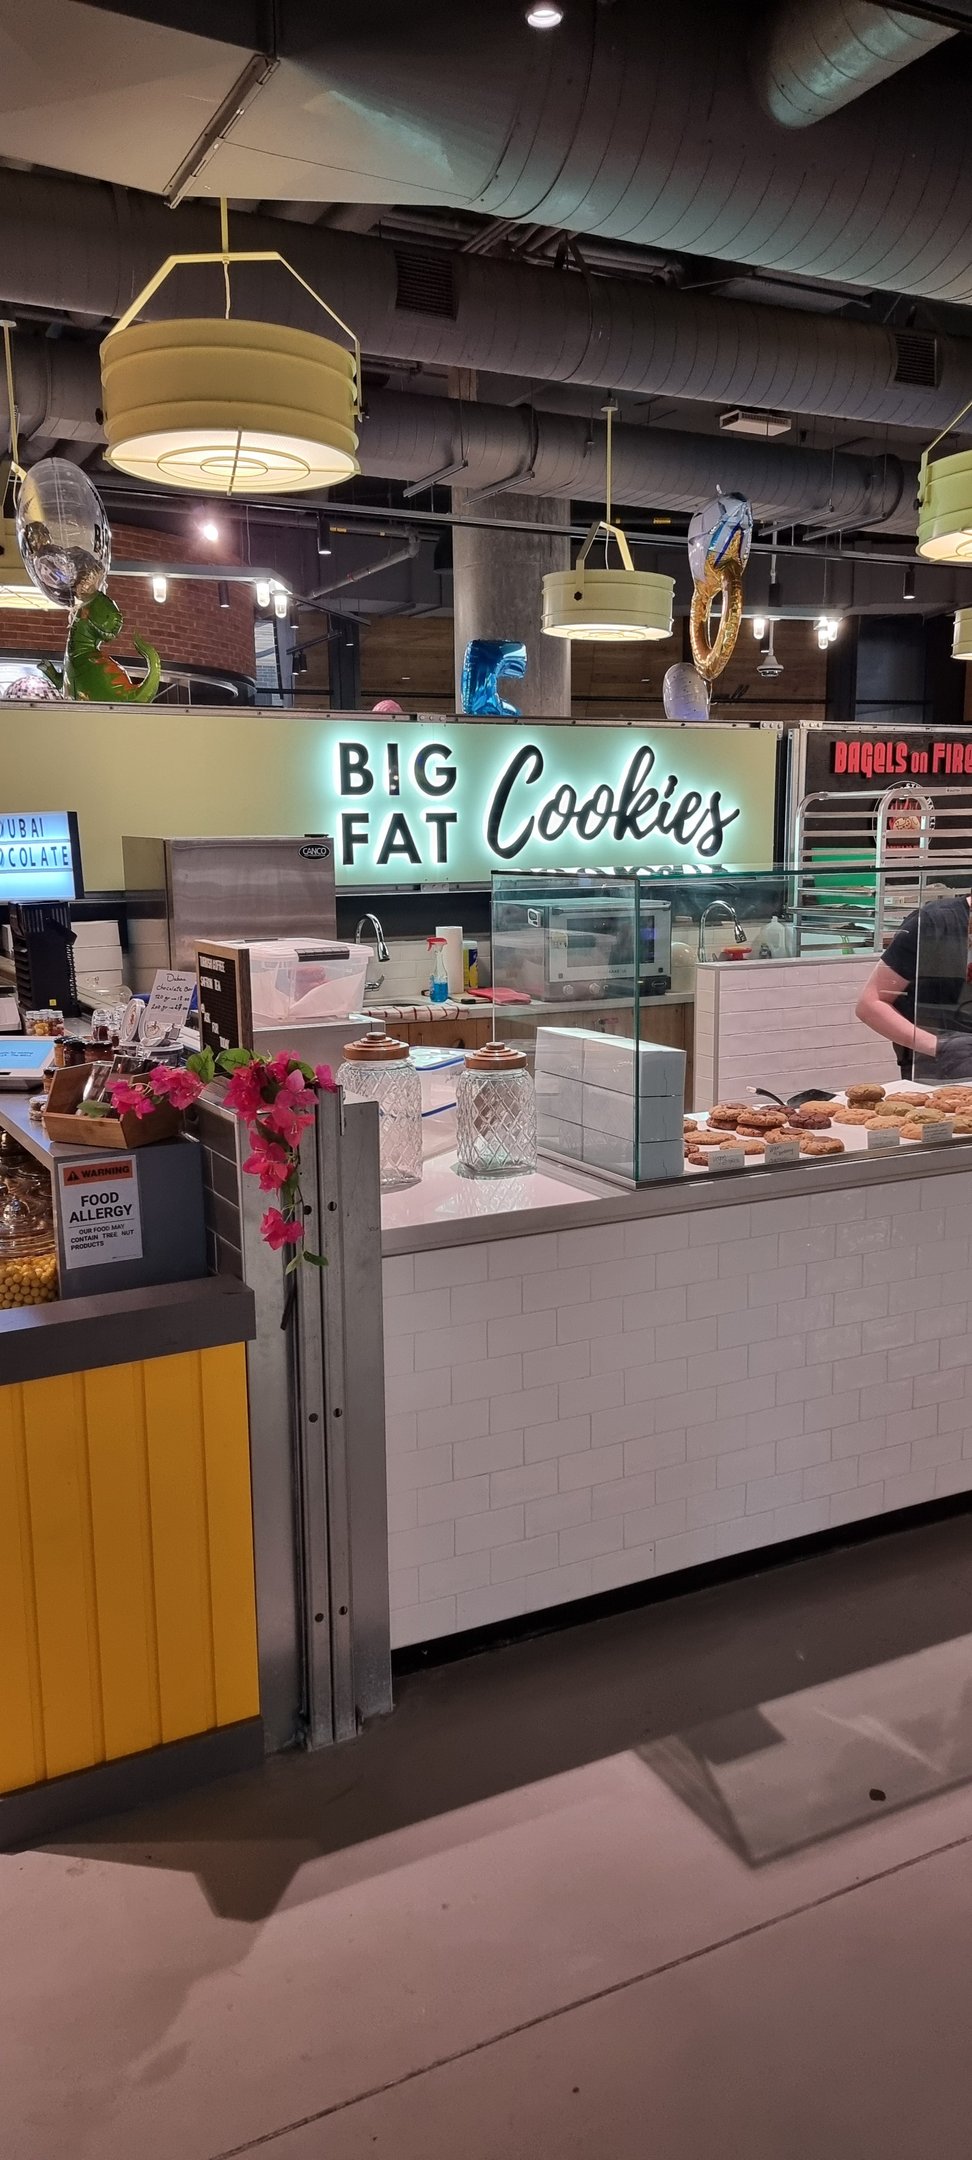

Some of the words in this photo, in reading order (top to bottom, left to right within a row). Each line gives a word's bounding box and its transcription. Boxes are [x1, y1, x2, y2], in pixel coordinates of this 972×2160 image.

[339, 742, 457, 797] BIG
[486, 744, 741, 860] Cookies
[341, 812, 458, 866] FAT
[302, 847, 327, 855] CANCO
[81, 1165, 130, 1178] WARNING
[81, 1191, 119, 1207] FOOD
[69, 1203, 133, 1223] ALLERGY
[93, 1225, 110, 1233] FOOD
[70, 1234, 99, 1244] CONTAIN
[102, 1231, 118, 1239] TREE
[70, 1240, 105, 1251] PRODUCTS
